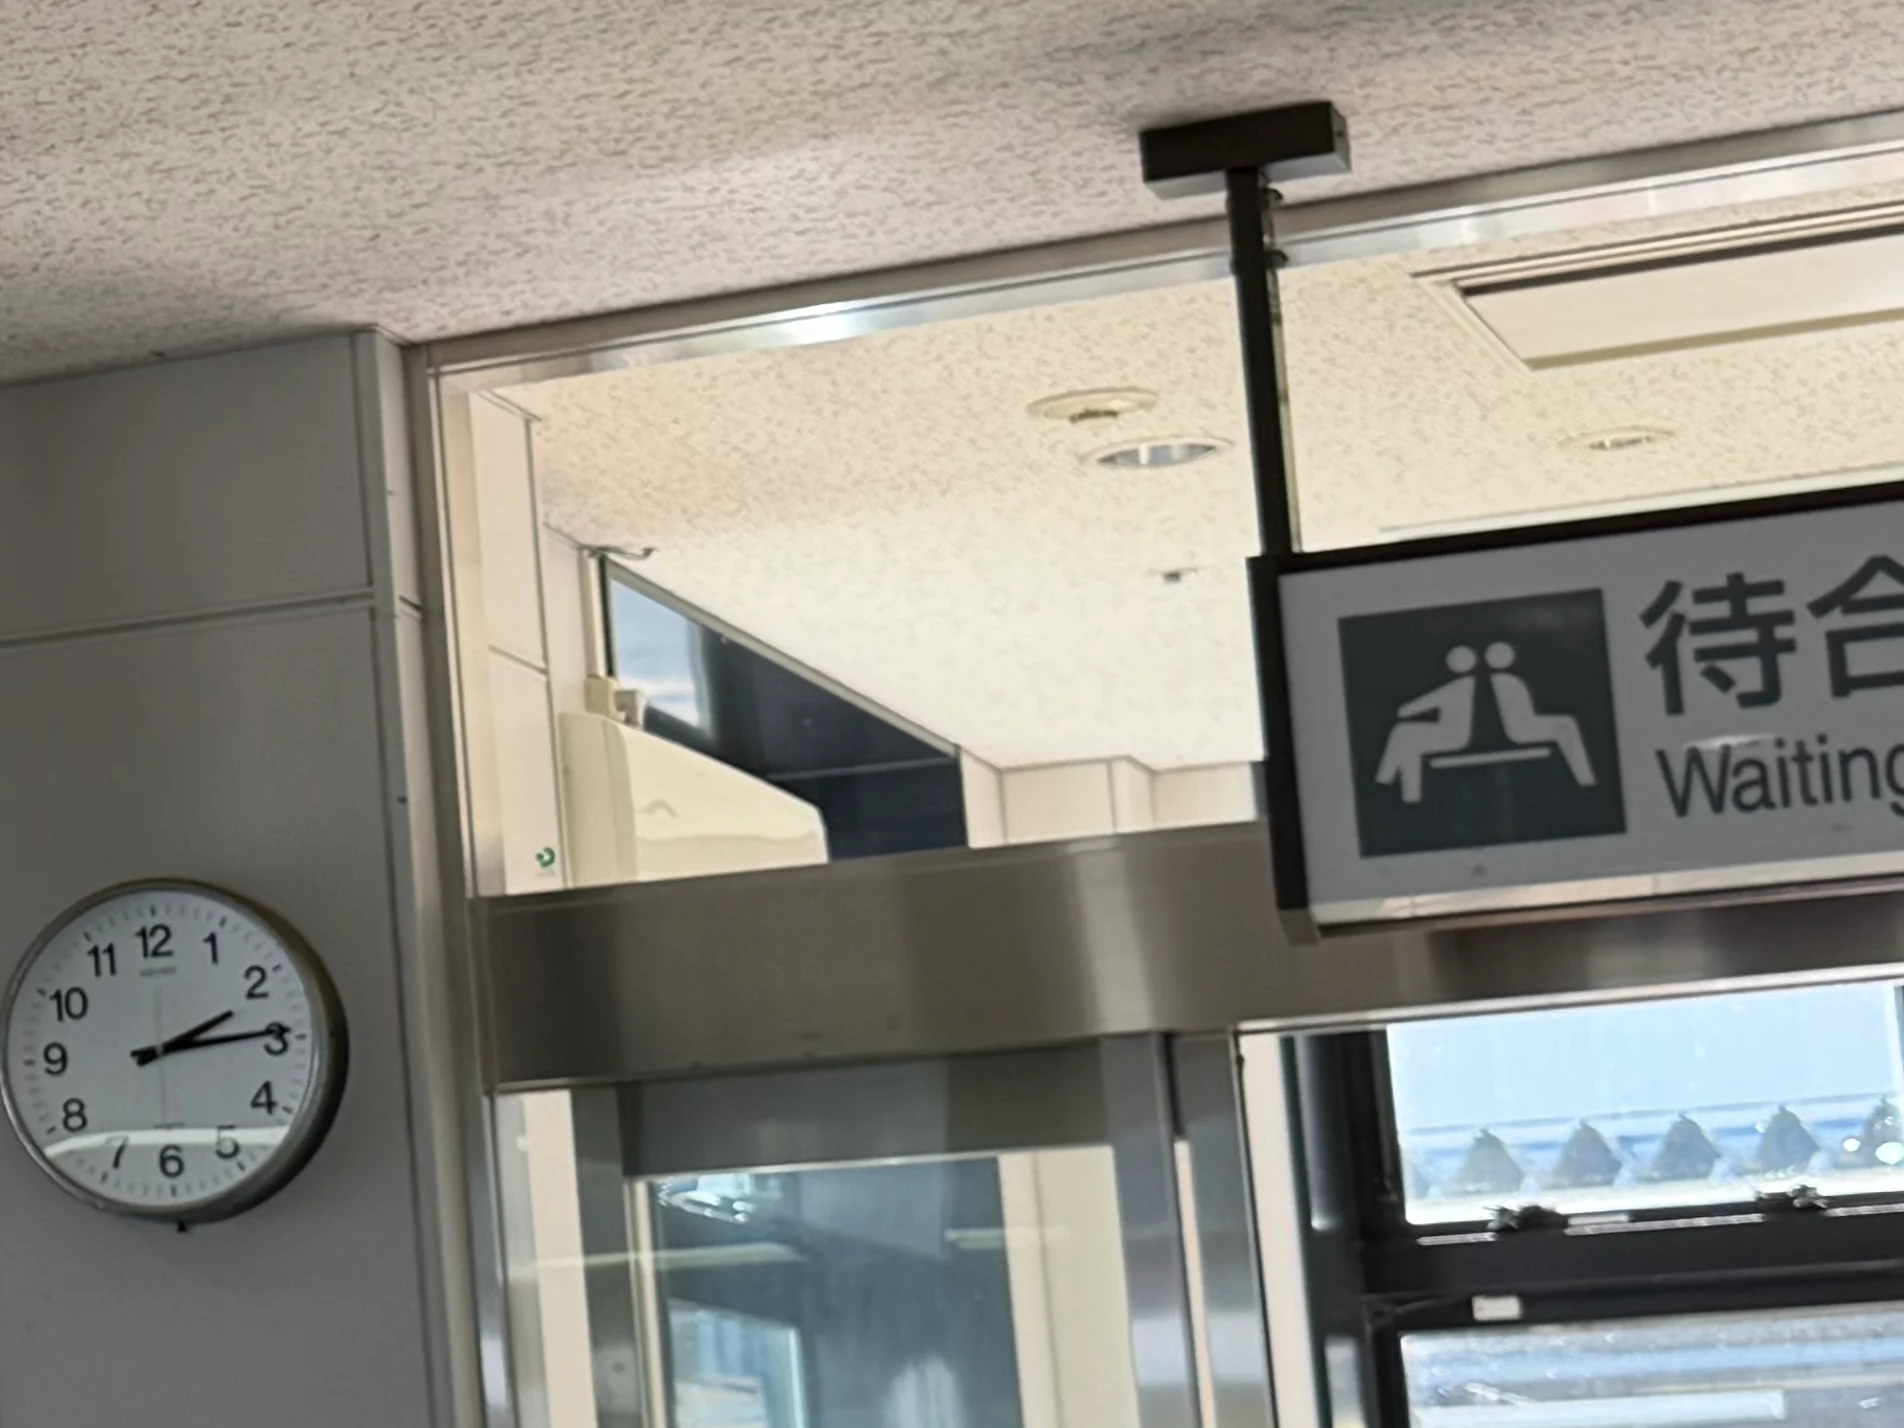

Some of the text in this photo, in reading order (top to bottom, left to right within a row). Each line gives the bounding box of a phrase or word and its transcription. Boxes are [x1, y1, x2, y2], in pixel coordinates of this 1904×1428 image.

[135, 923, 174, 959] 12
[202, 932, 219, 965] 1
[87, 942, 117, 978] 11
[243, 964, 269, 1000] 2
[49, 986, 89, 1022] 10
[263, 1021, 290, 1057] 3
[43, 1041, 68, 1076] 9
[62, 1097, 89, 1133] 8
[250, 1080, 278, 1115] 4
[105, 1135, 130, 1170] 7
[214, 1124, 241, 1161] 5
[158, 1143, 185, 1179] 6
